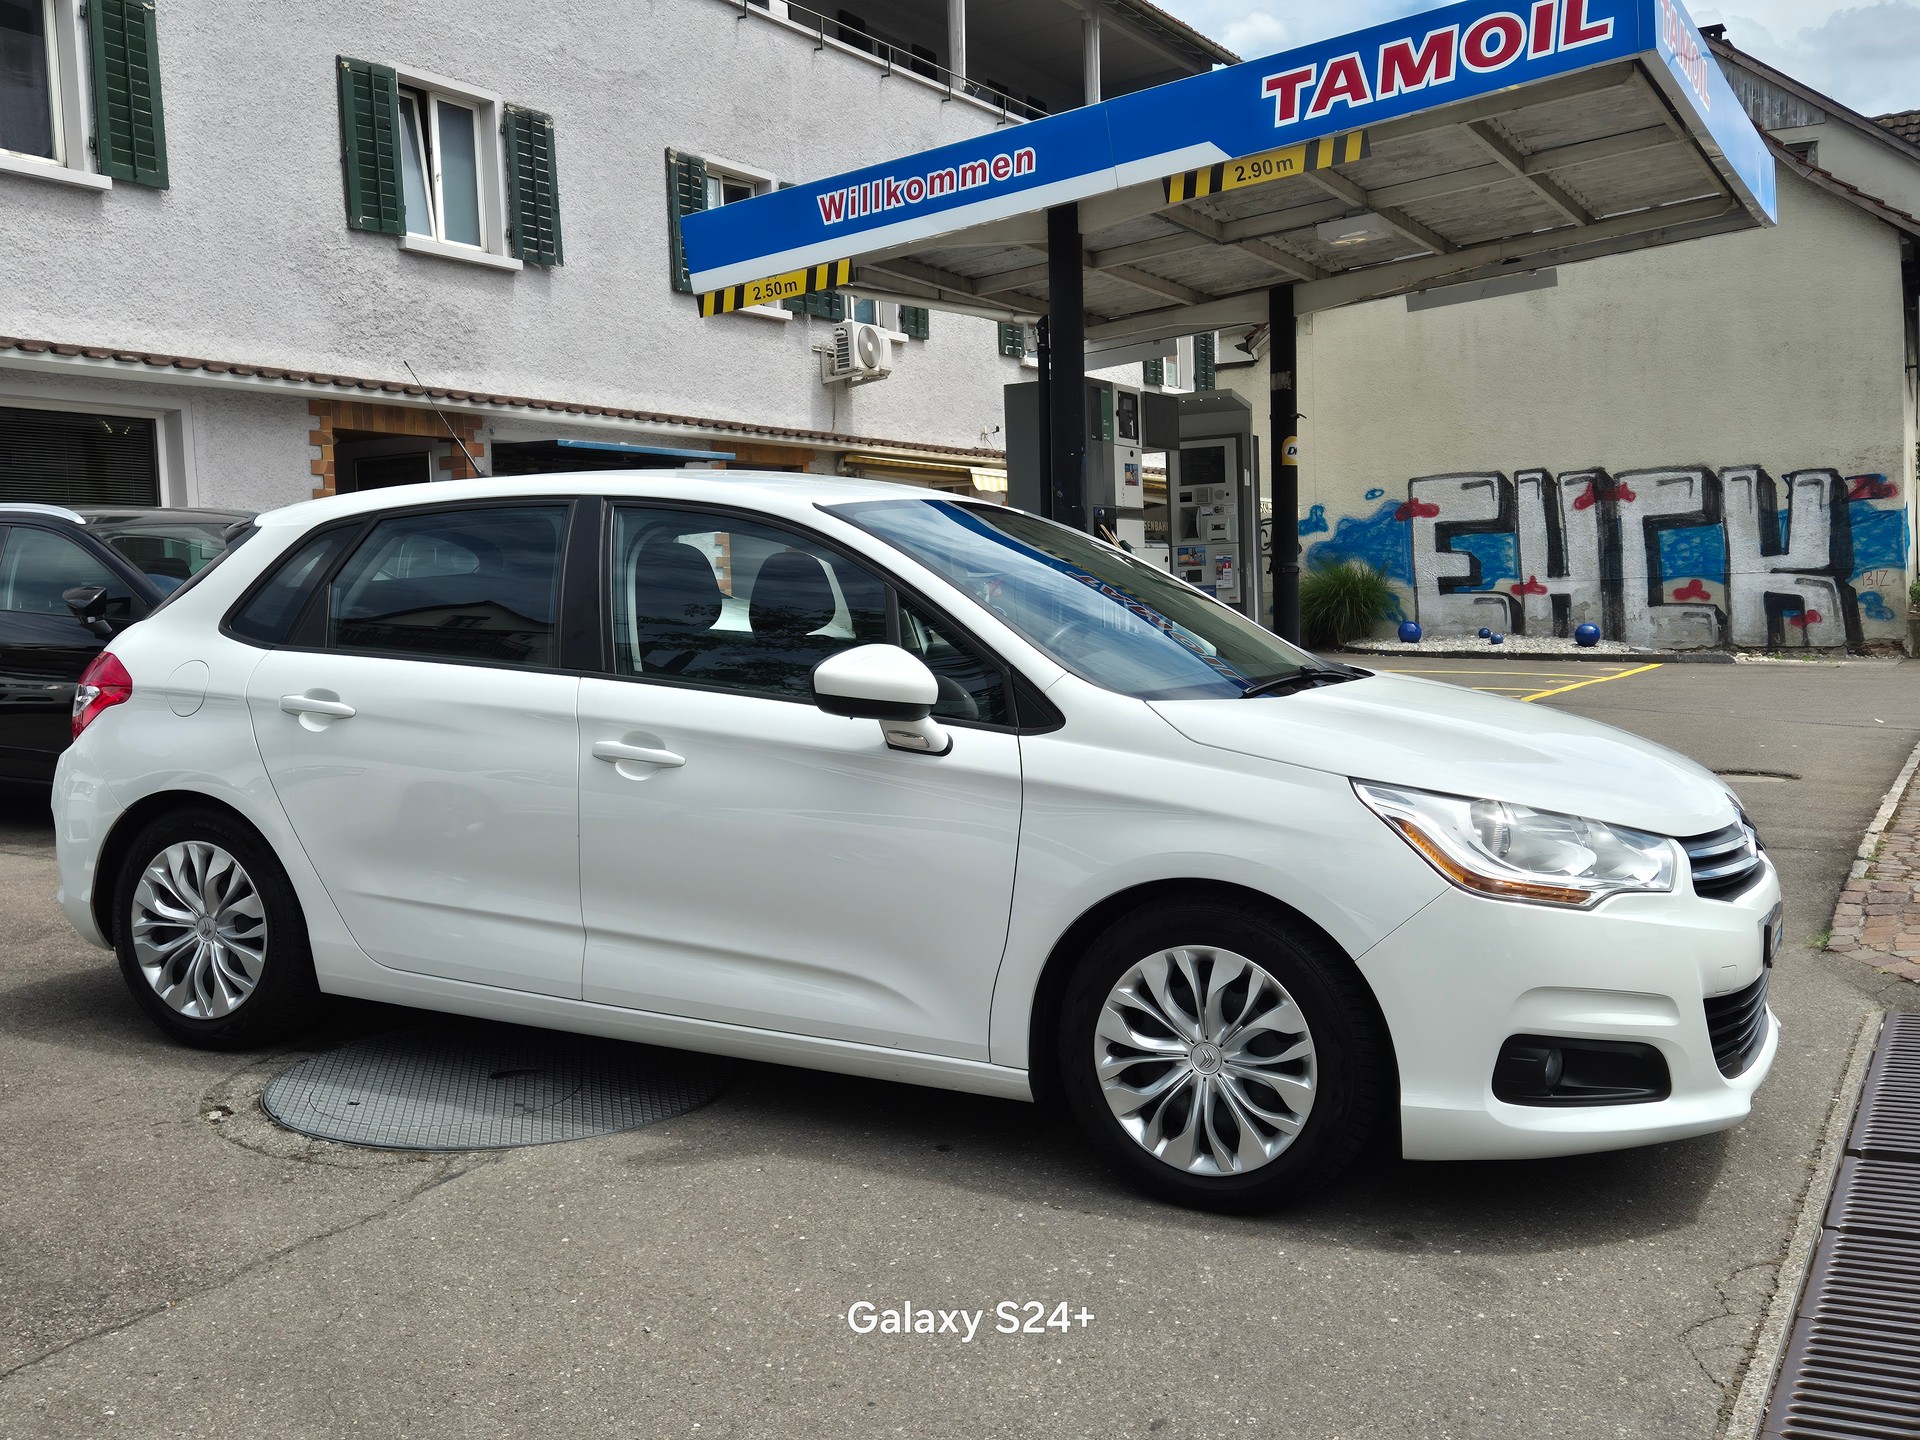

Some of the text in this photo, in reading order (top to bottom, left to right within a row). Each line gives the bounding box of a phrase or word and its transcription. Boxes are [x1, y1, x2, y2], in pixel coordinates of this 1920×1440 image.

[1261, 0, 1615, 128] TAMOIL
[1660, 0, 1711, 113] TAMOIL
[816, 146, 1036, 226] Willkommen
